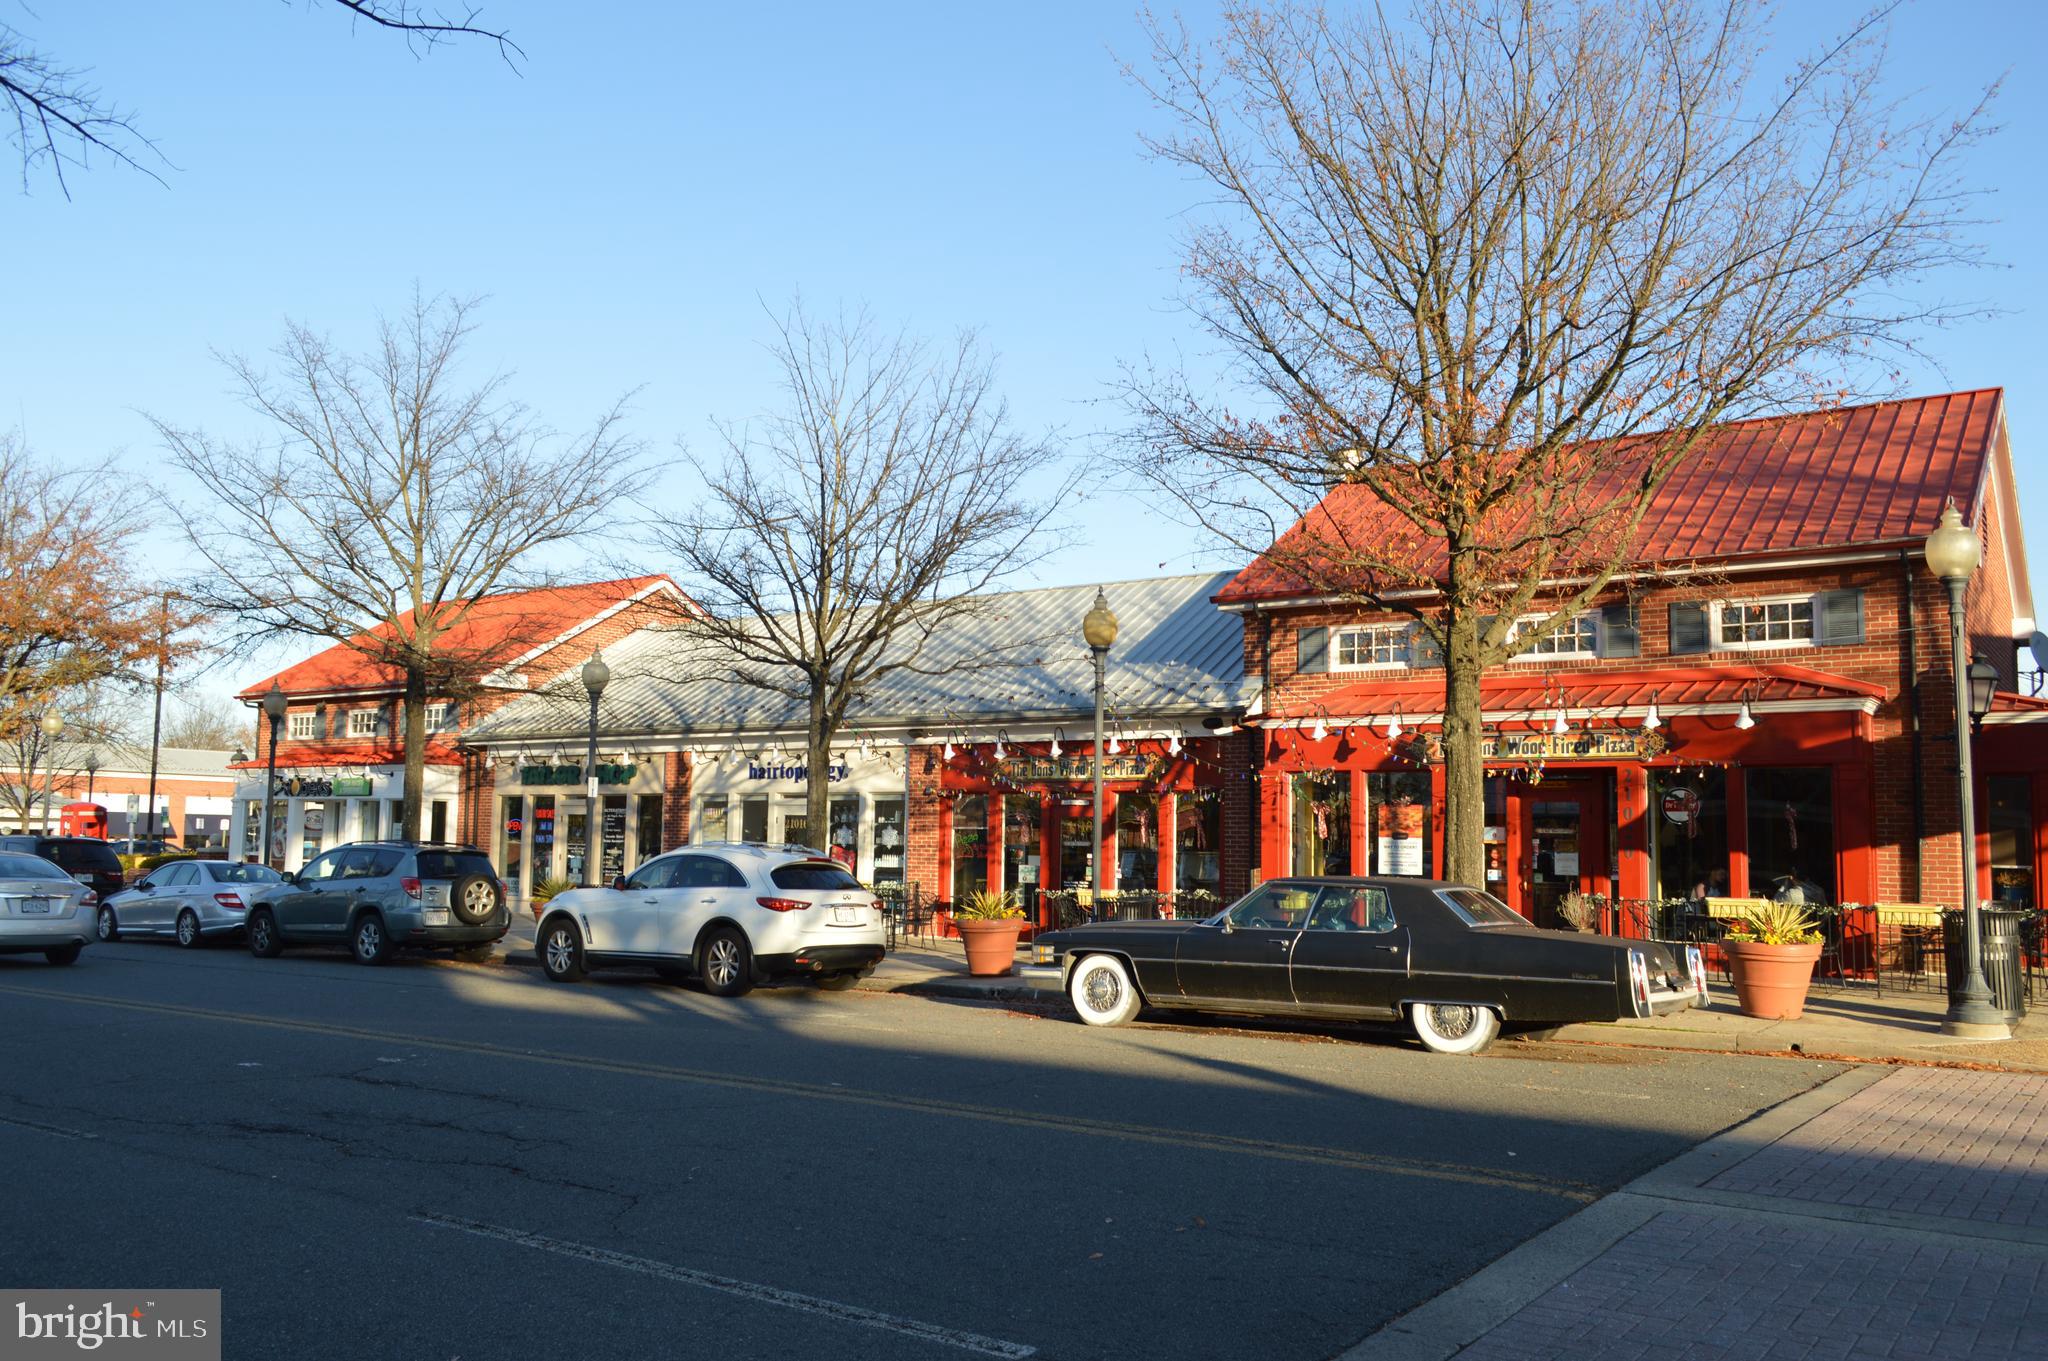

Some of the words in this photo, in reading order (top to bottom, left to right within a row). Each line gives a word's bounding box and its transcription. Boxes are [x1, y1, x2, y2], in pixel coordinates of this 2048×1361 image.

[1595, 734, 1635, 753] Pizza
[520, 765, 581, 785] TAILOR
[1010, 761, 1028, 777] The
